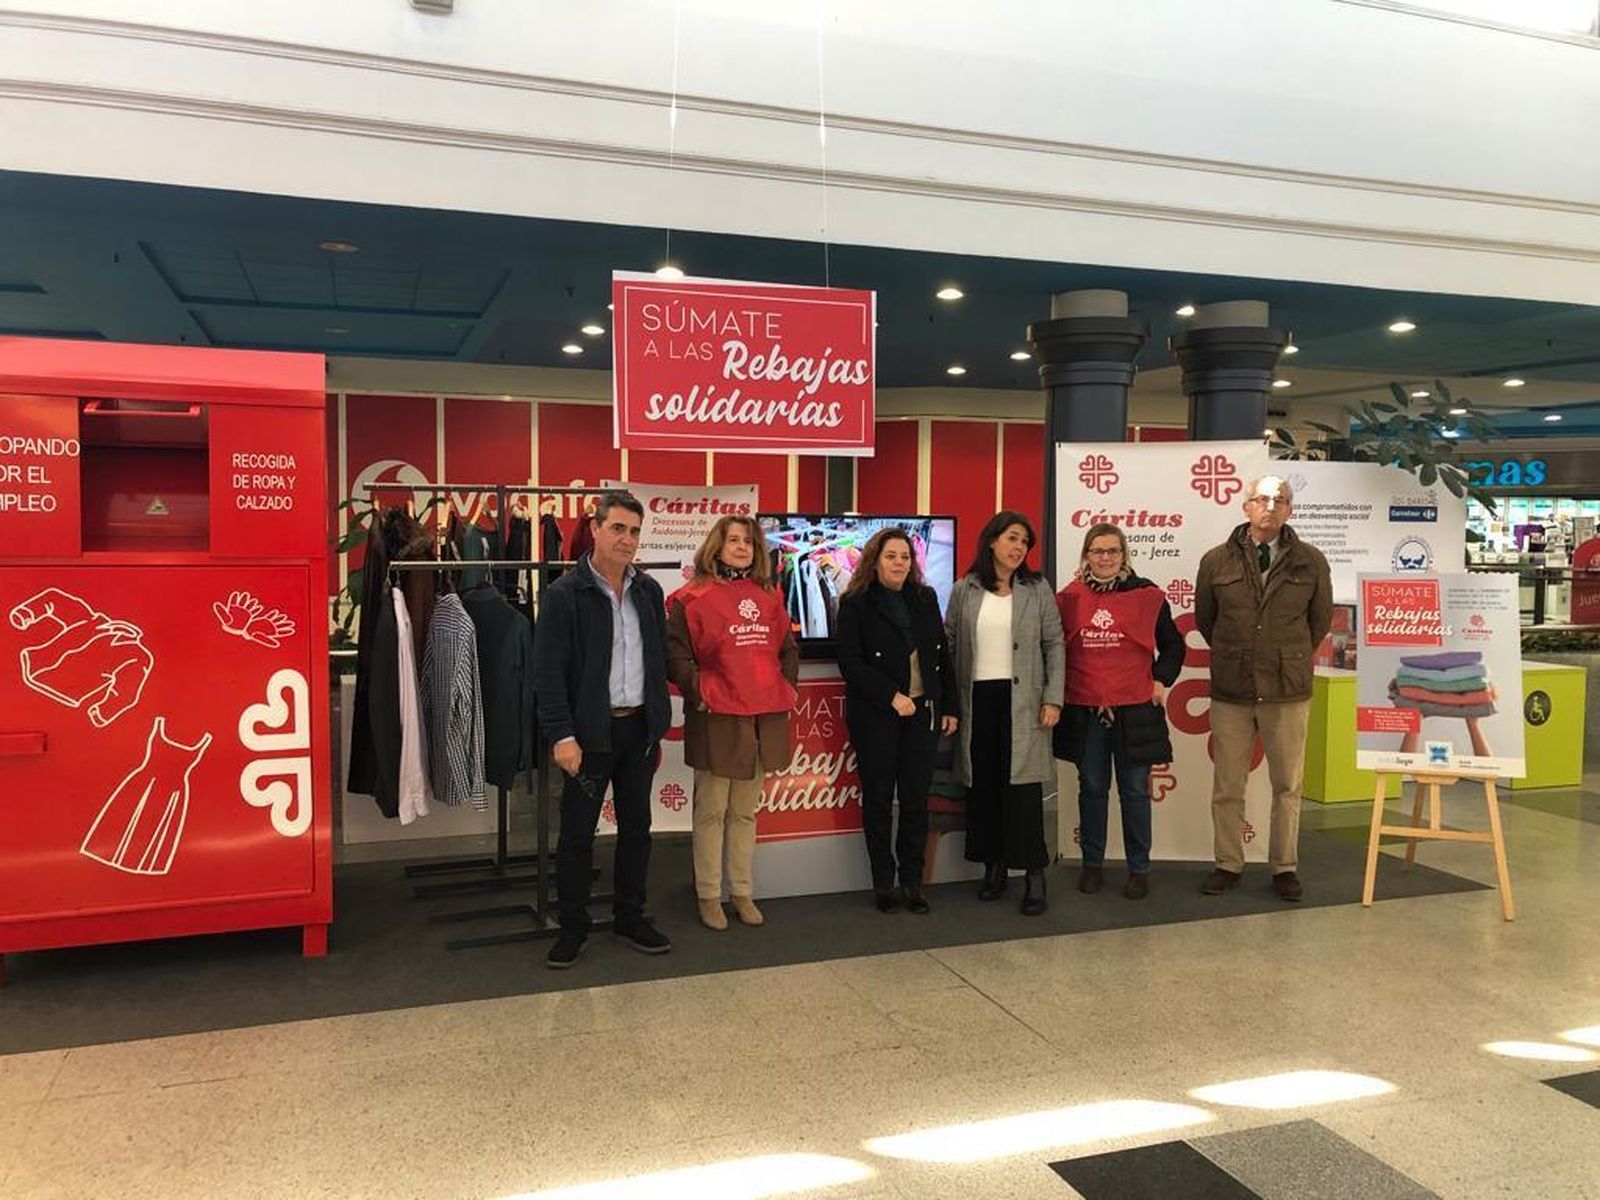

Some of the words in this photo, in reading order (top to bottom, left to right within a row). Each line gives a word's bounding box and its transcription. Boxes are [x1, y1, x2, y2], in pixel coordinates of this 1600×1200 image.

[642, 299, 783, 340] SÚMATE
[643, 340, 660, 359] A
[669, 342, 713, 361] LAS
[722, 340, 871, 396] Rebajas
[232, 453, 296, 469] RECOGIDA
[28, 466, 52, 484] EL
[233, 474, 250, 489] DE
[252, 475, 286, 490] ROPA
[287, 476, 297, 490] Y
[0, 494, 57, 512] PLEO
[236, 495, 293, 511] CALZADO
[649, 496, 751, 516] Cáritas
[1070, 509, 1184, 529] Cáritas
[1160, 532, 1175, 543] de
[1371, 585, 1433, 598] SÚMATE
[1375, 605, 1440, 624] Rebajas
[796, 722, 835, 739] LAS
